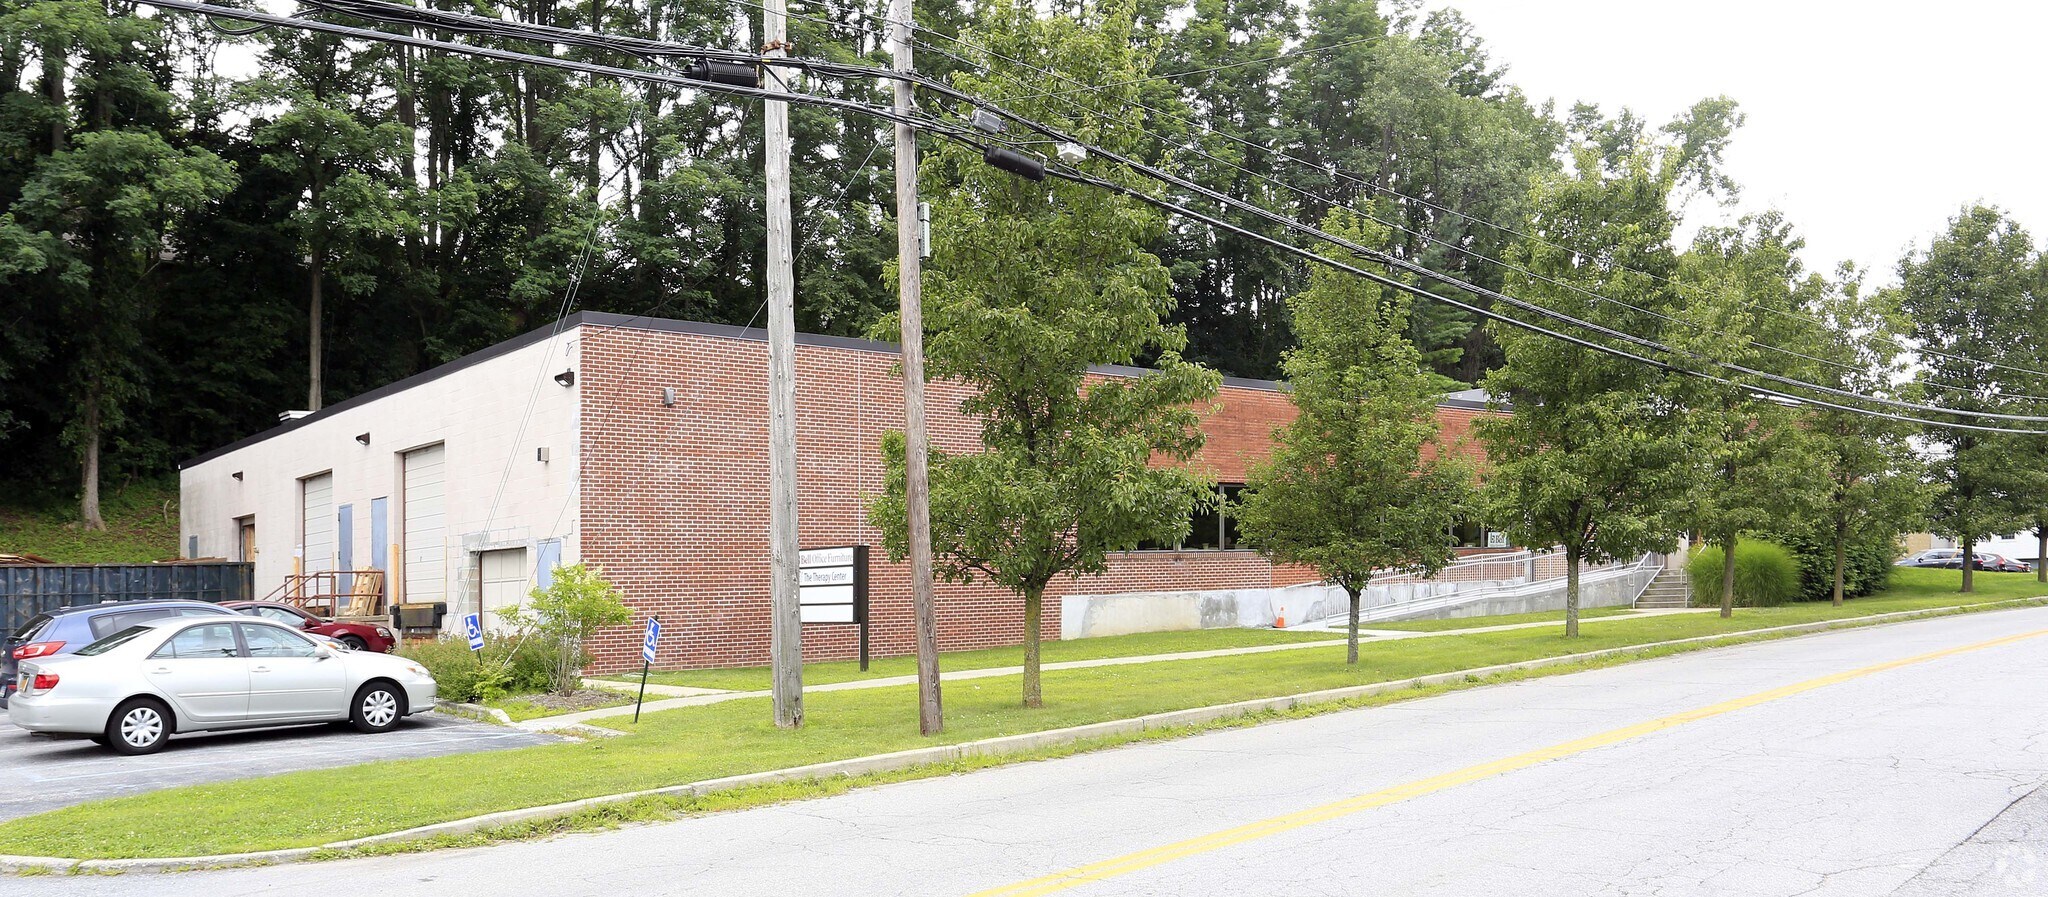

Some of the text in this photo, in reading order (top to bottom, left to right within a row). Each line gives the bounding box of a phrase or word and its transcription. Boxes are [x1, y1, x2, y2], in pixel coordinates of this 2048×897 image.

[801, 552, 853, 564] Bell Office Furniture
[804, 571, 847, 583] The Therapy Center
